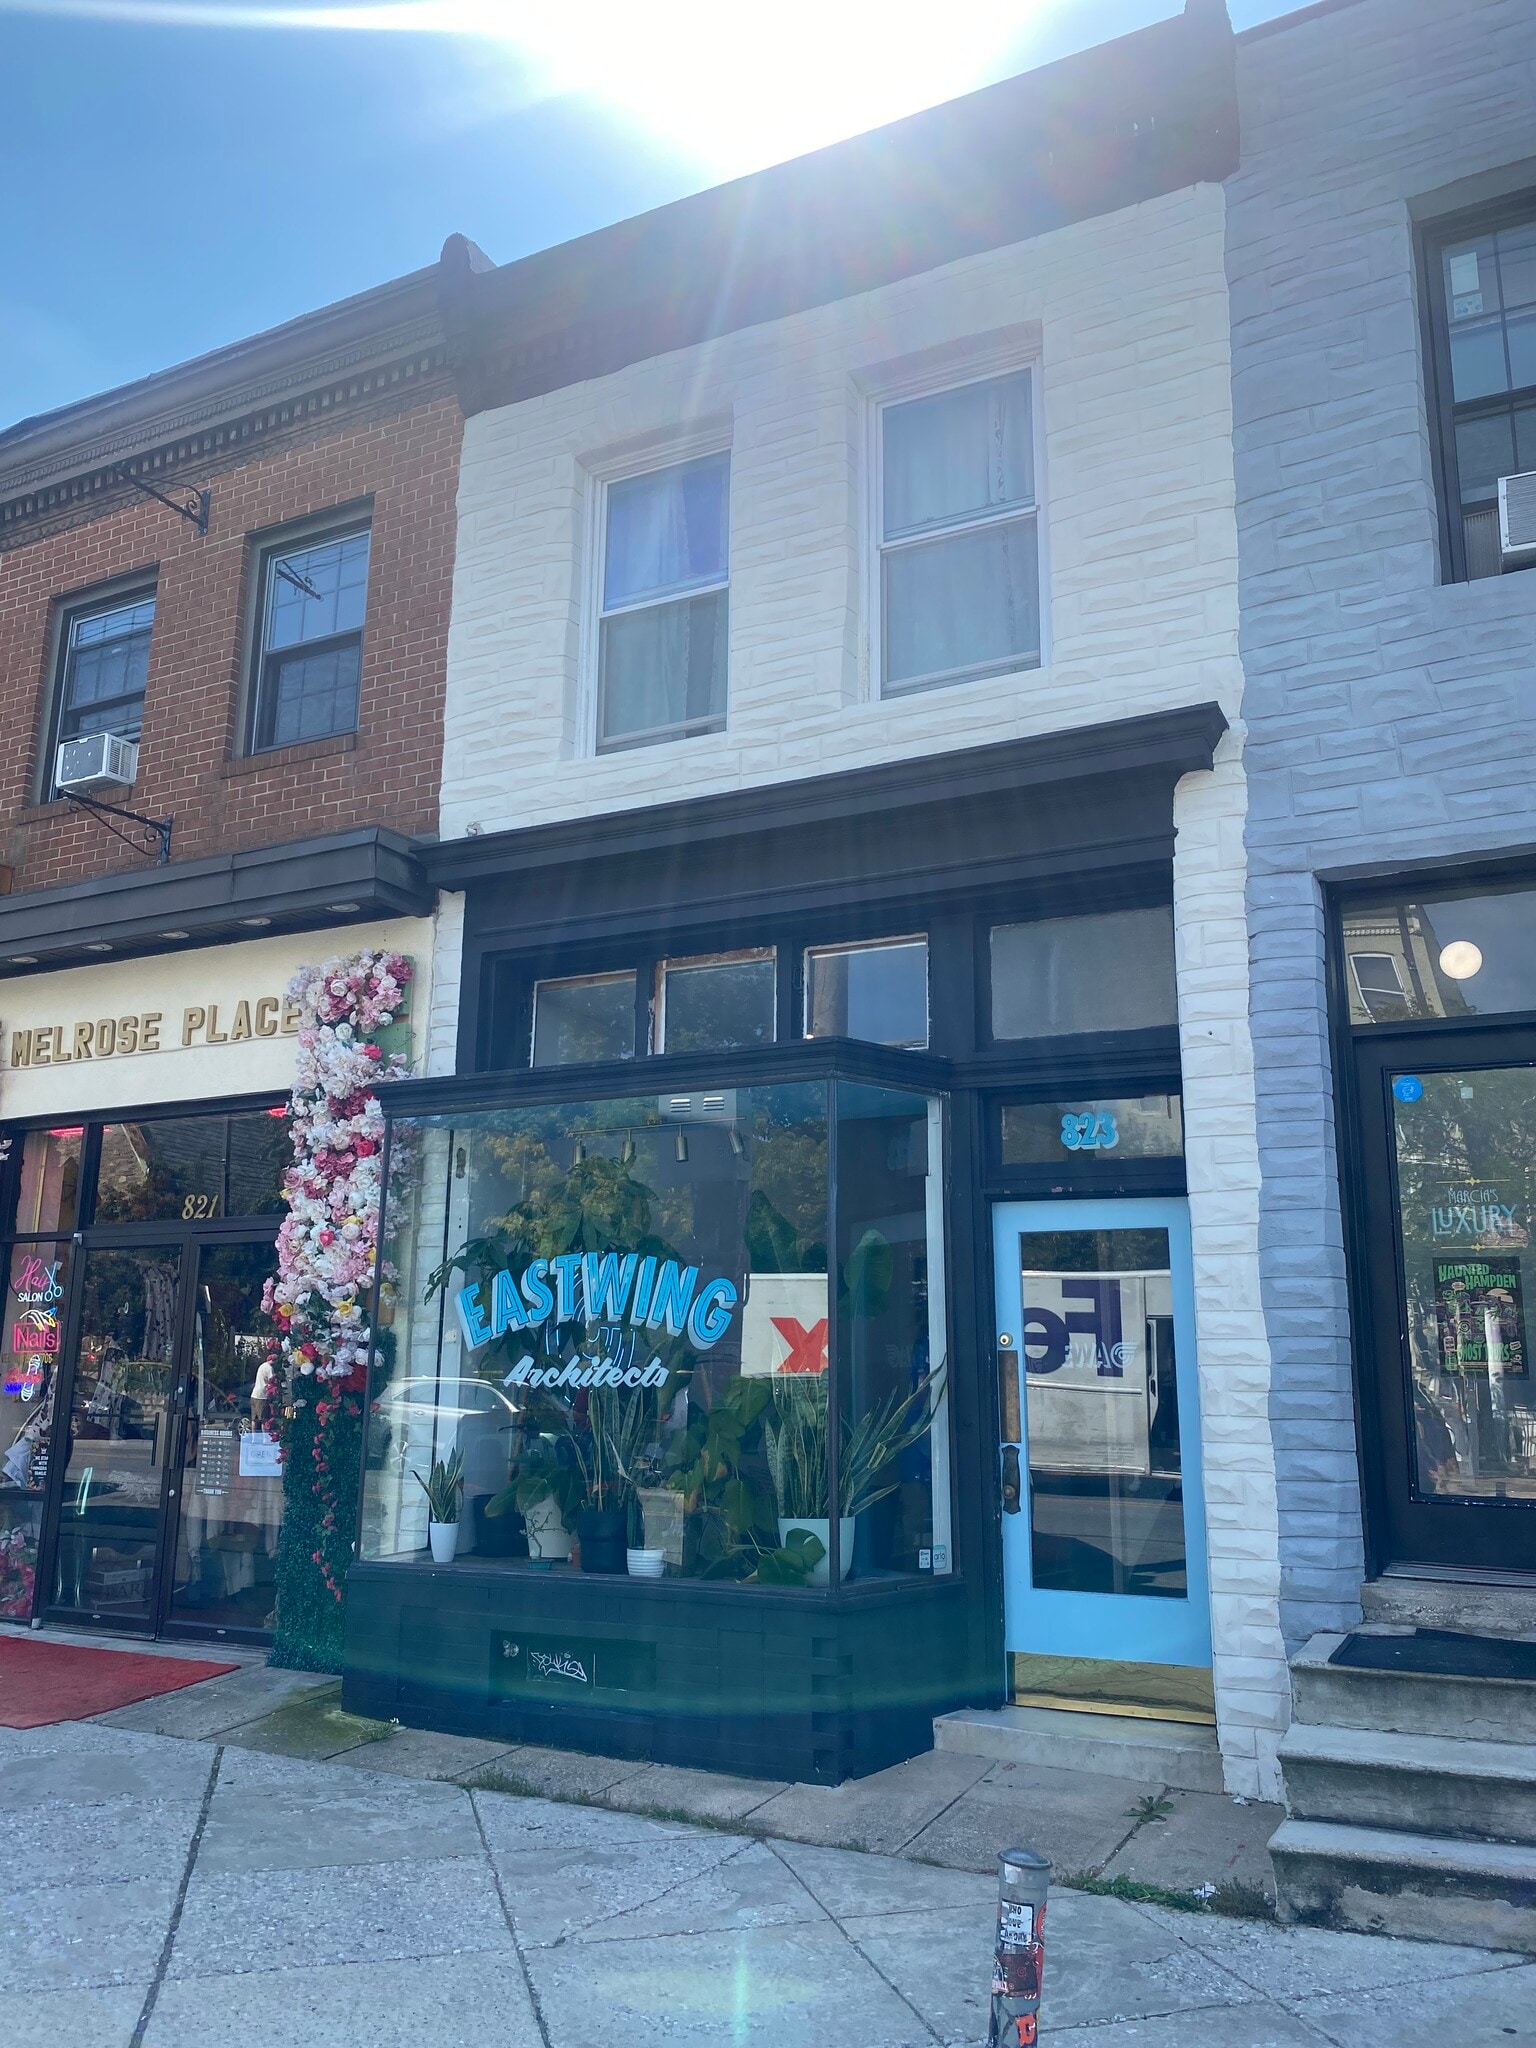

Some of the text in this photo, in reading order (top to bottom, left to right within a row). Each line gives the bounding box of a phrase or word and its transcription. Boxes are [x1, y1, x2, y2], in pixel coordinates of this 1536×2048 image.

[11, 997, 302, 1067] MELROSE PLACE
[1061, 1111, 1119, 1150] 823
[182, 1194, 219, 1220] 821
[1431, 1204, 1518, 1235] LUXURY
[1438, 1264, 1490, 1282] HAUNTED
[1465, 1275, 1517, 1290] HAMPDEN
[18, 1292, 43, 1302] SALON
[454, 1252, 738, 1351] EASTWING
[16, 1327, 56, 1349] Nails
[503, 1355, 670, 1388] Architects
